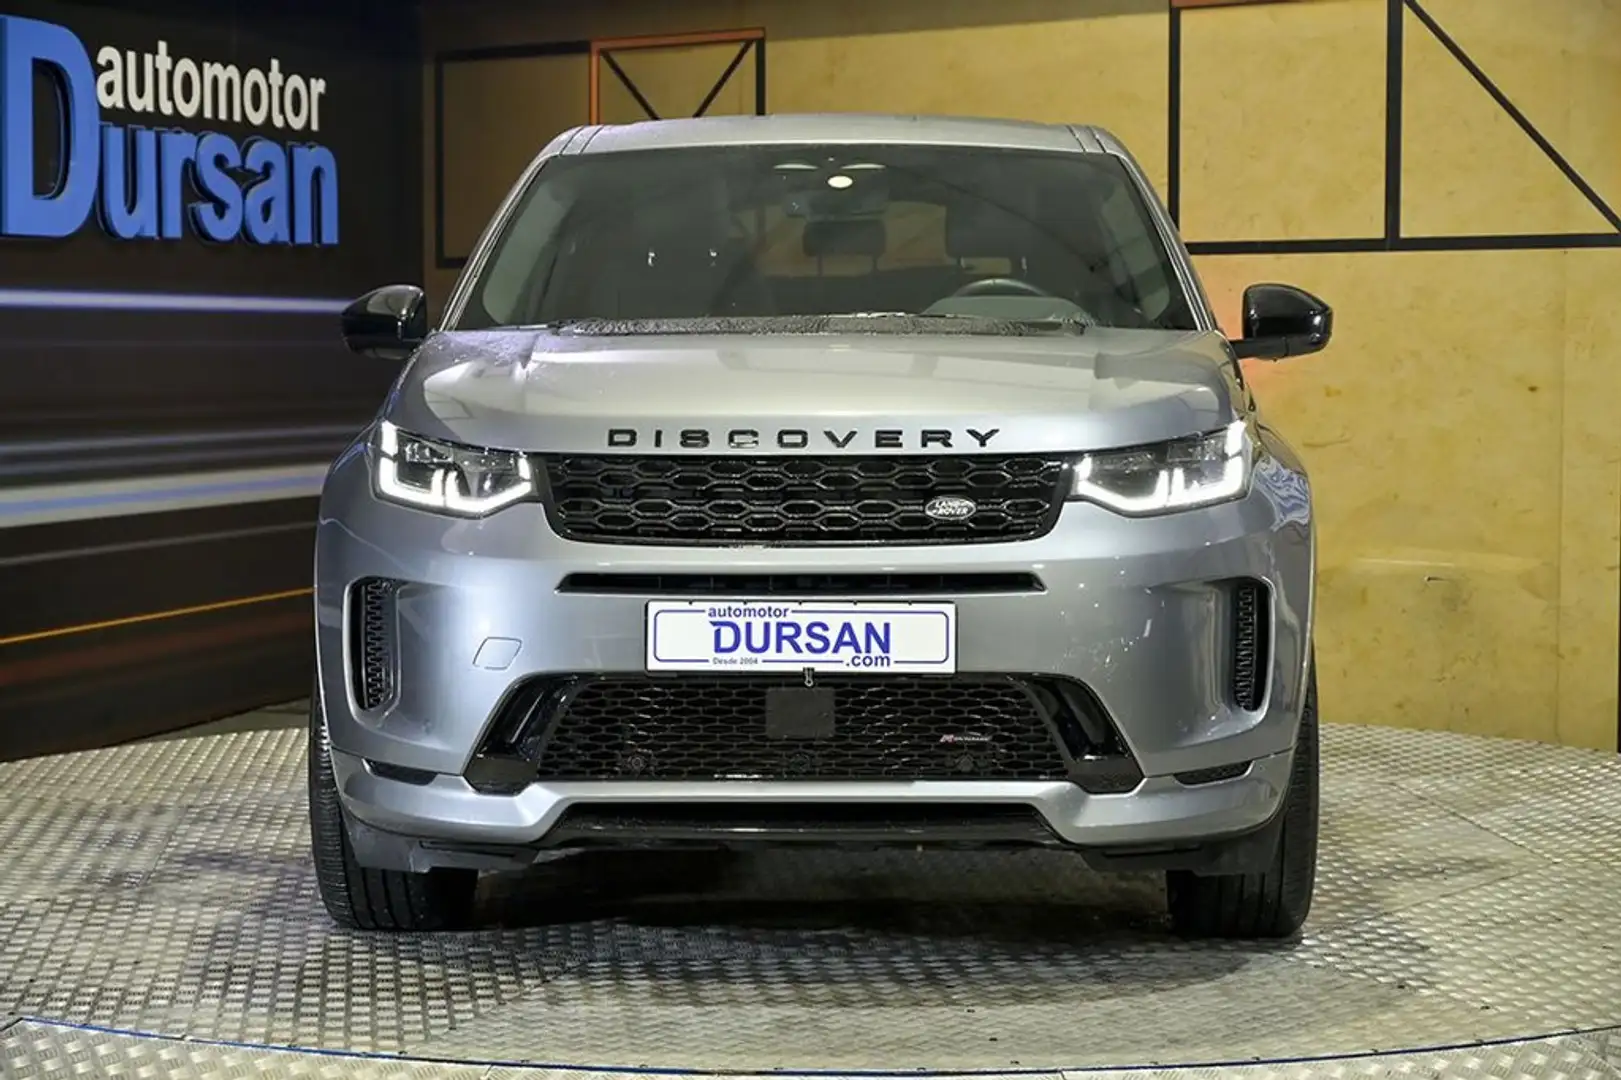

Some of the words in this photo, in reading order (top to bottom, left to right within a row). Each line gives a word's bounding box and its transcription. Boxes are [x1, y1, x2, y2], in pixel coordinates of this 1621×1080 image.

[96, 40, 326, 131] automotor
[0, 14, 339, 244] Dursan
[607, 428, 1000, 449] DISCOVERY
[708, 606, 790, 618] automotor
[709, 621, 891, 654] DURSAN
[845, 655, 891, 668] .com
